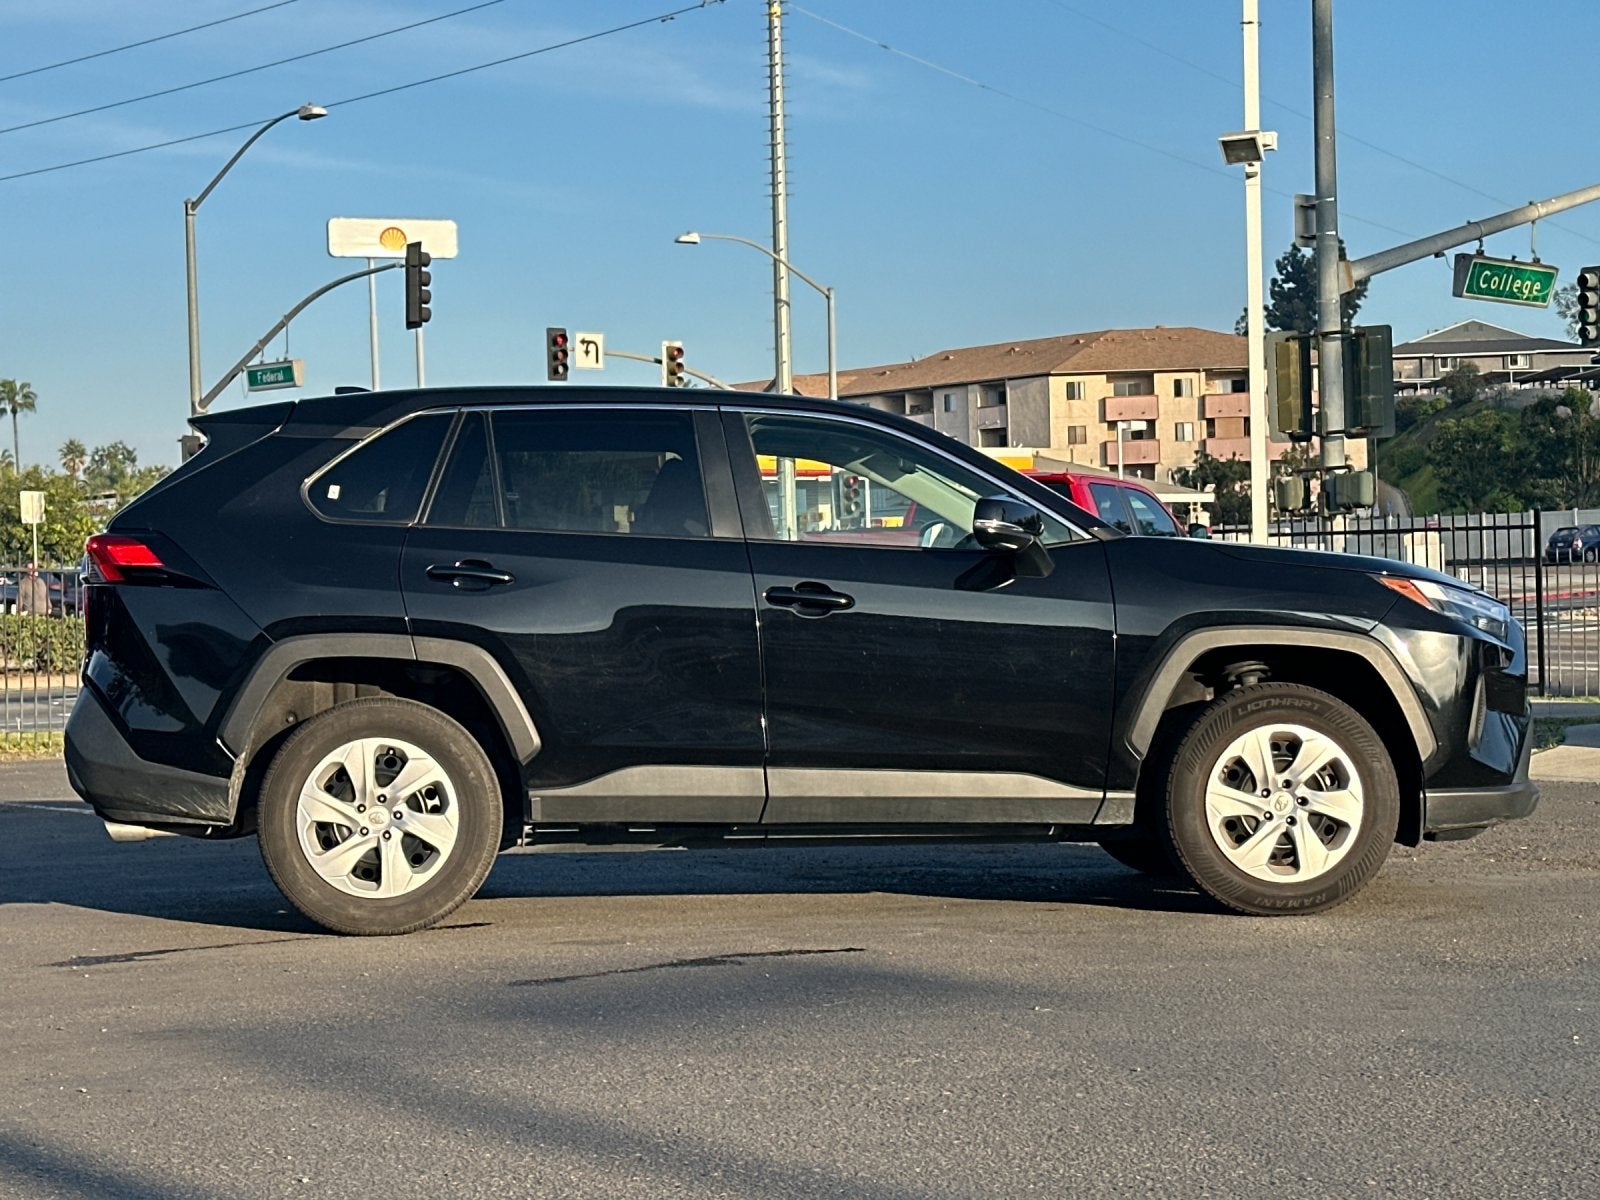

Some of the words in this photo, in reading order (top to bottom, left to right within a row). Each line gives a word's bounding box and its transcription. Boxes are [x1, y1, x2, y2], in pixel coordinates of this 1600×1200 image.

[1480, 271, 1541, 299] College
[257, 371, 284, 384] Federal
[1238, 697, 1321, 715] LIONHART
